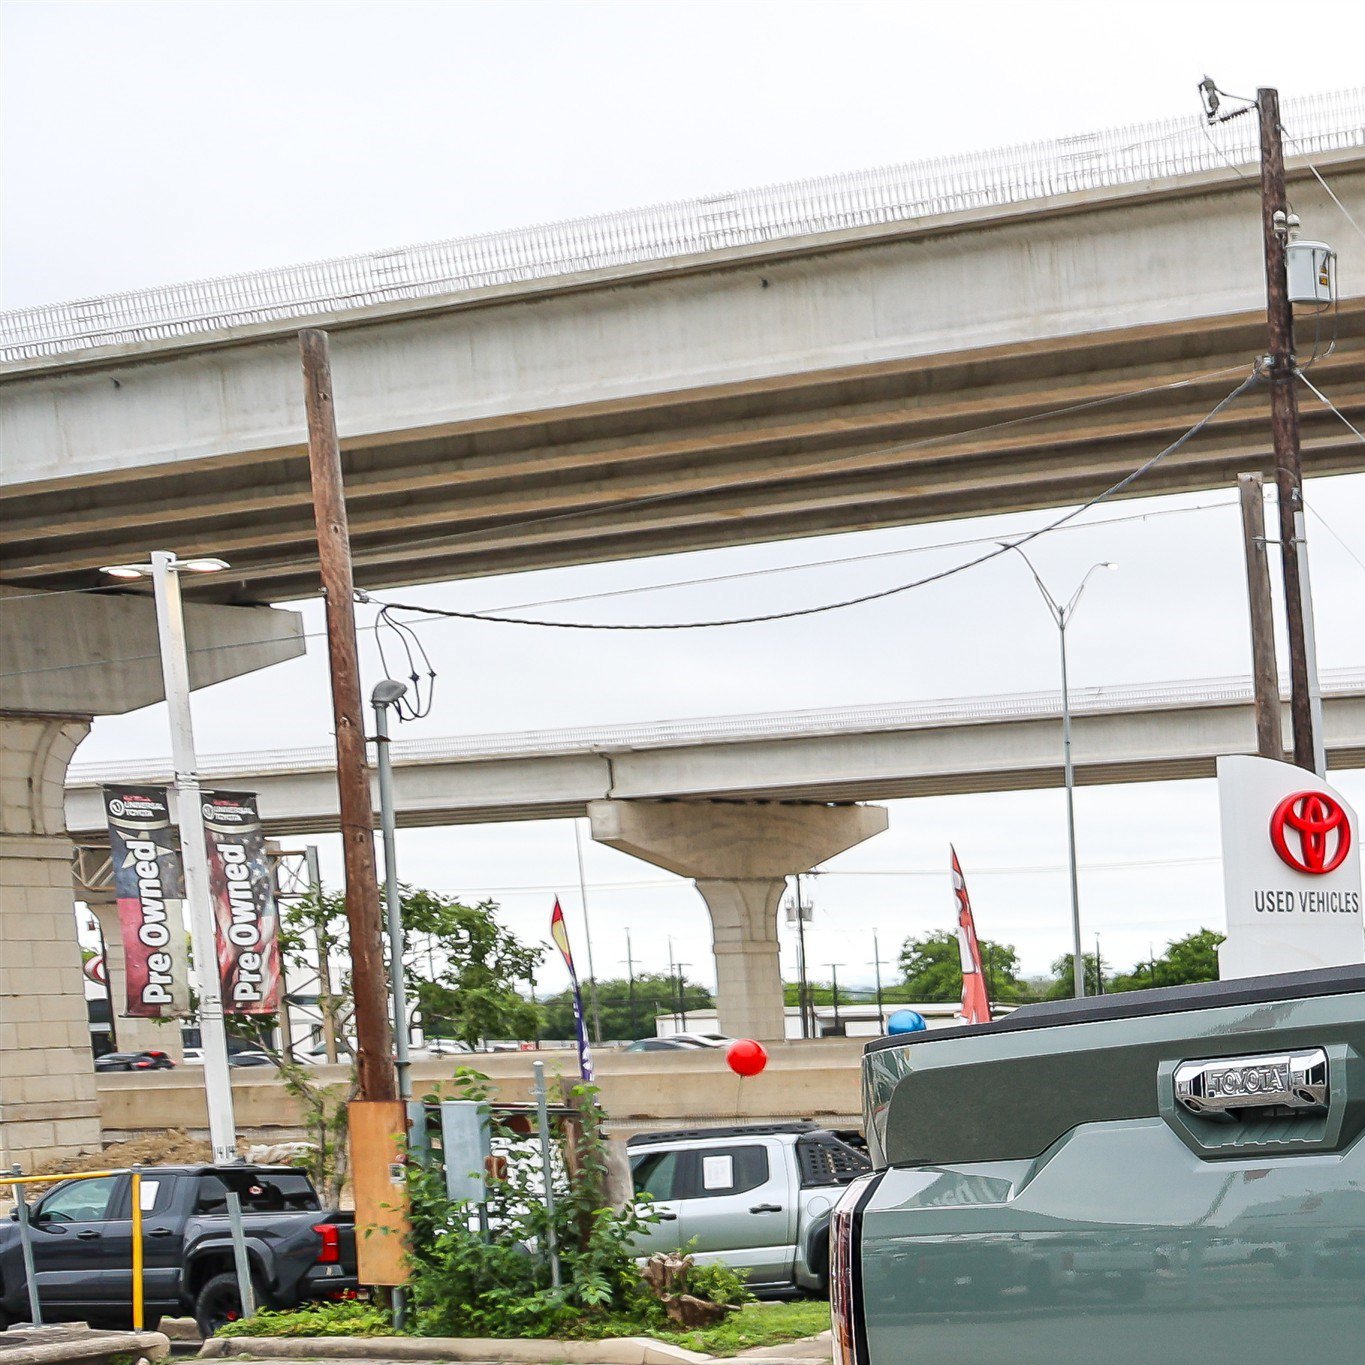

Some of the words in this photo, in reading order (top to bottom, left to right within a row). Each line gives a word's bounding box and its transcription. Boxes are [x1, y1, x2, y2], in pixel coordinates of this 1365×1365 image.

[126, 841, 170, 947] Owned
[216, 843, 261, 947] Owned
[1254, 890, 1295, 913] USED
[1299, 891, 1359, 913] VEHICLES
[143, 952, 173, 1004] Pre
[233, 952, 262, 1002] Pre
[1212, 1067, 1285, 1094] TOYOTA
